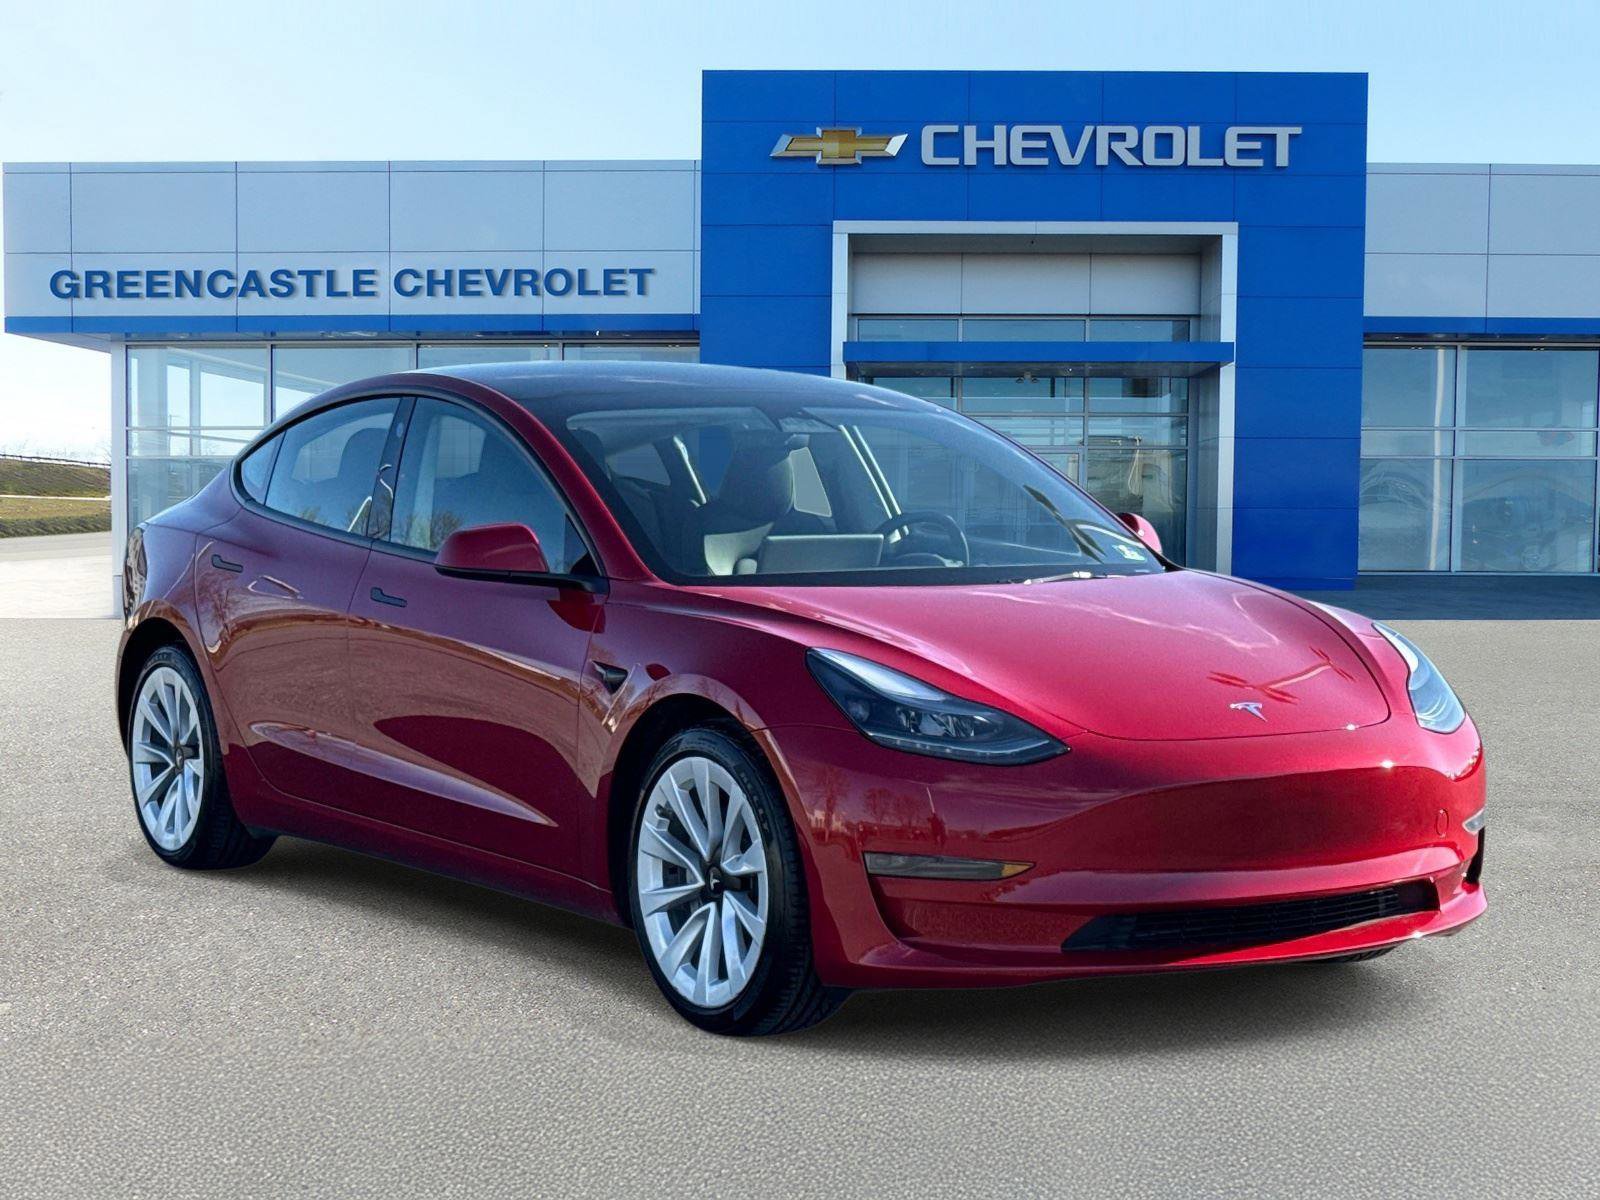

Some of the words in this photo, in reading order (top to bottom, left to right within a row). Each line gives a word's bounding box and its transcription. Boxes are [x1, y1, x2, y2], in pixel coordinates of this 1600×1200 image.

[921, 124, 1303, 168] CHEVROLET
[50, 269, 379, 300] GREENCASTLE
[394, 267, 655, 298] CHEVROLET
